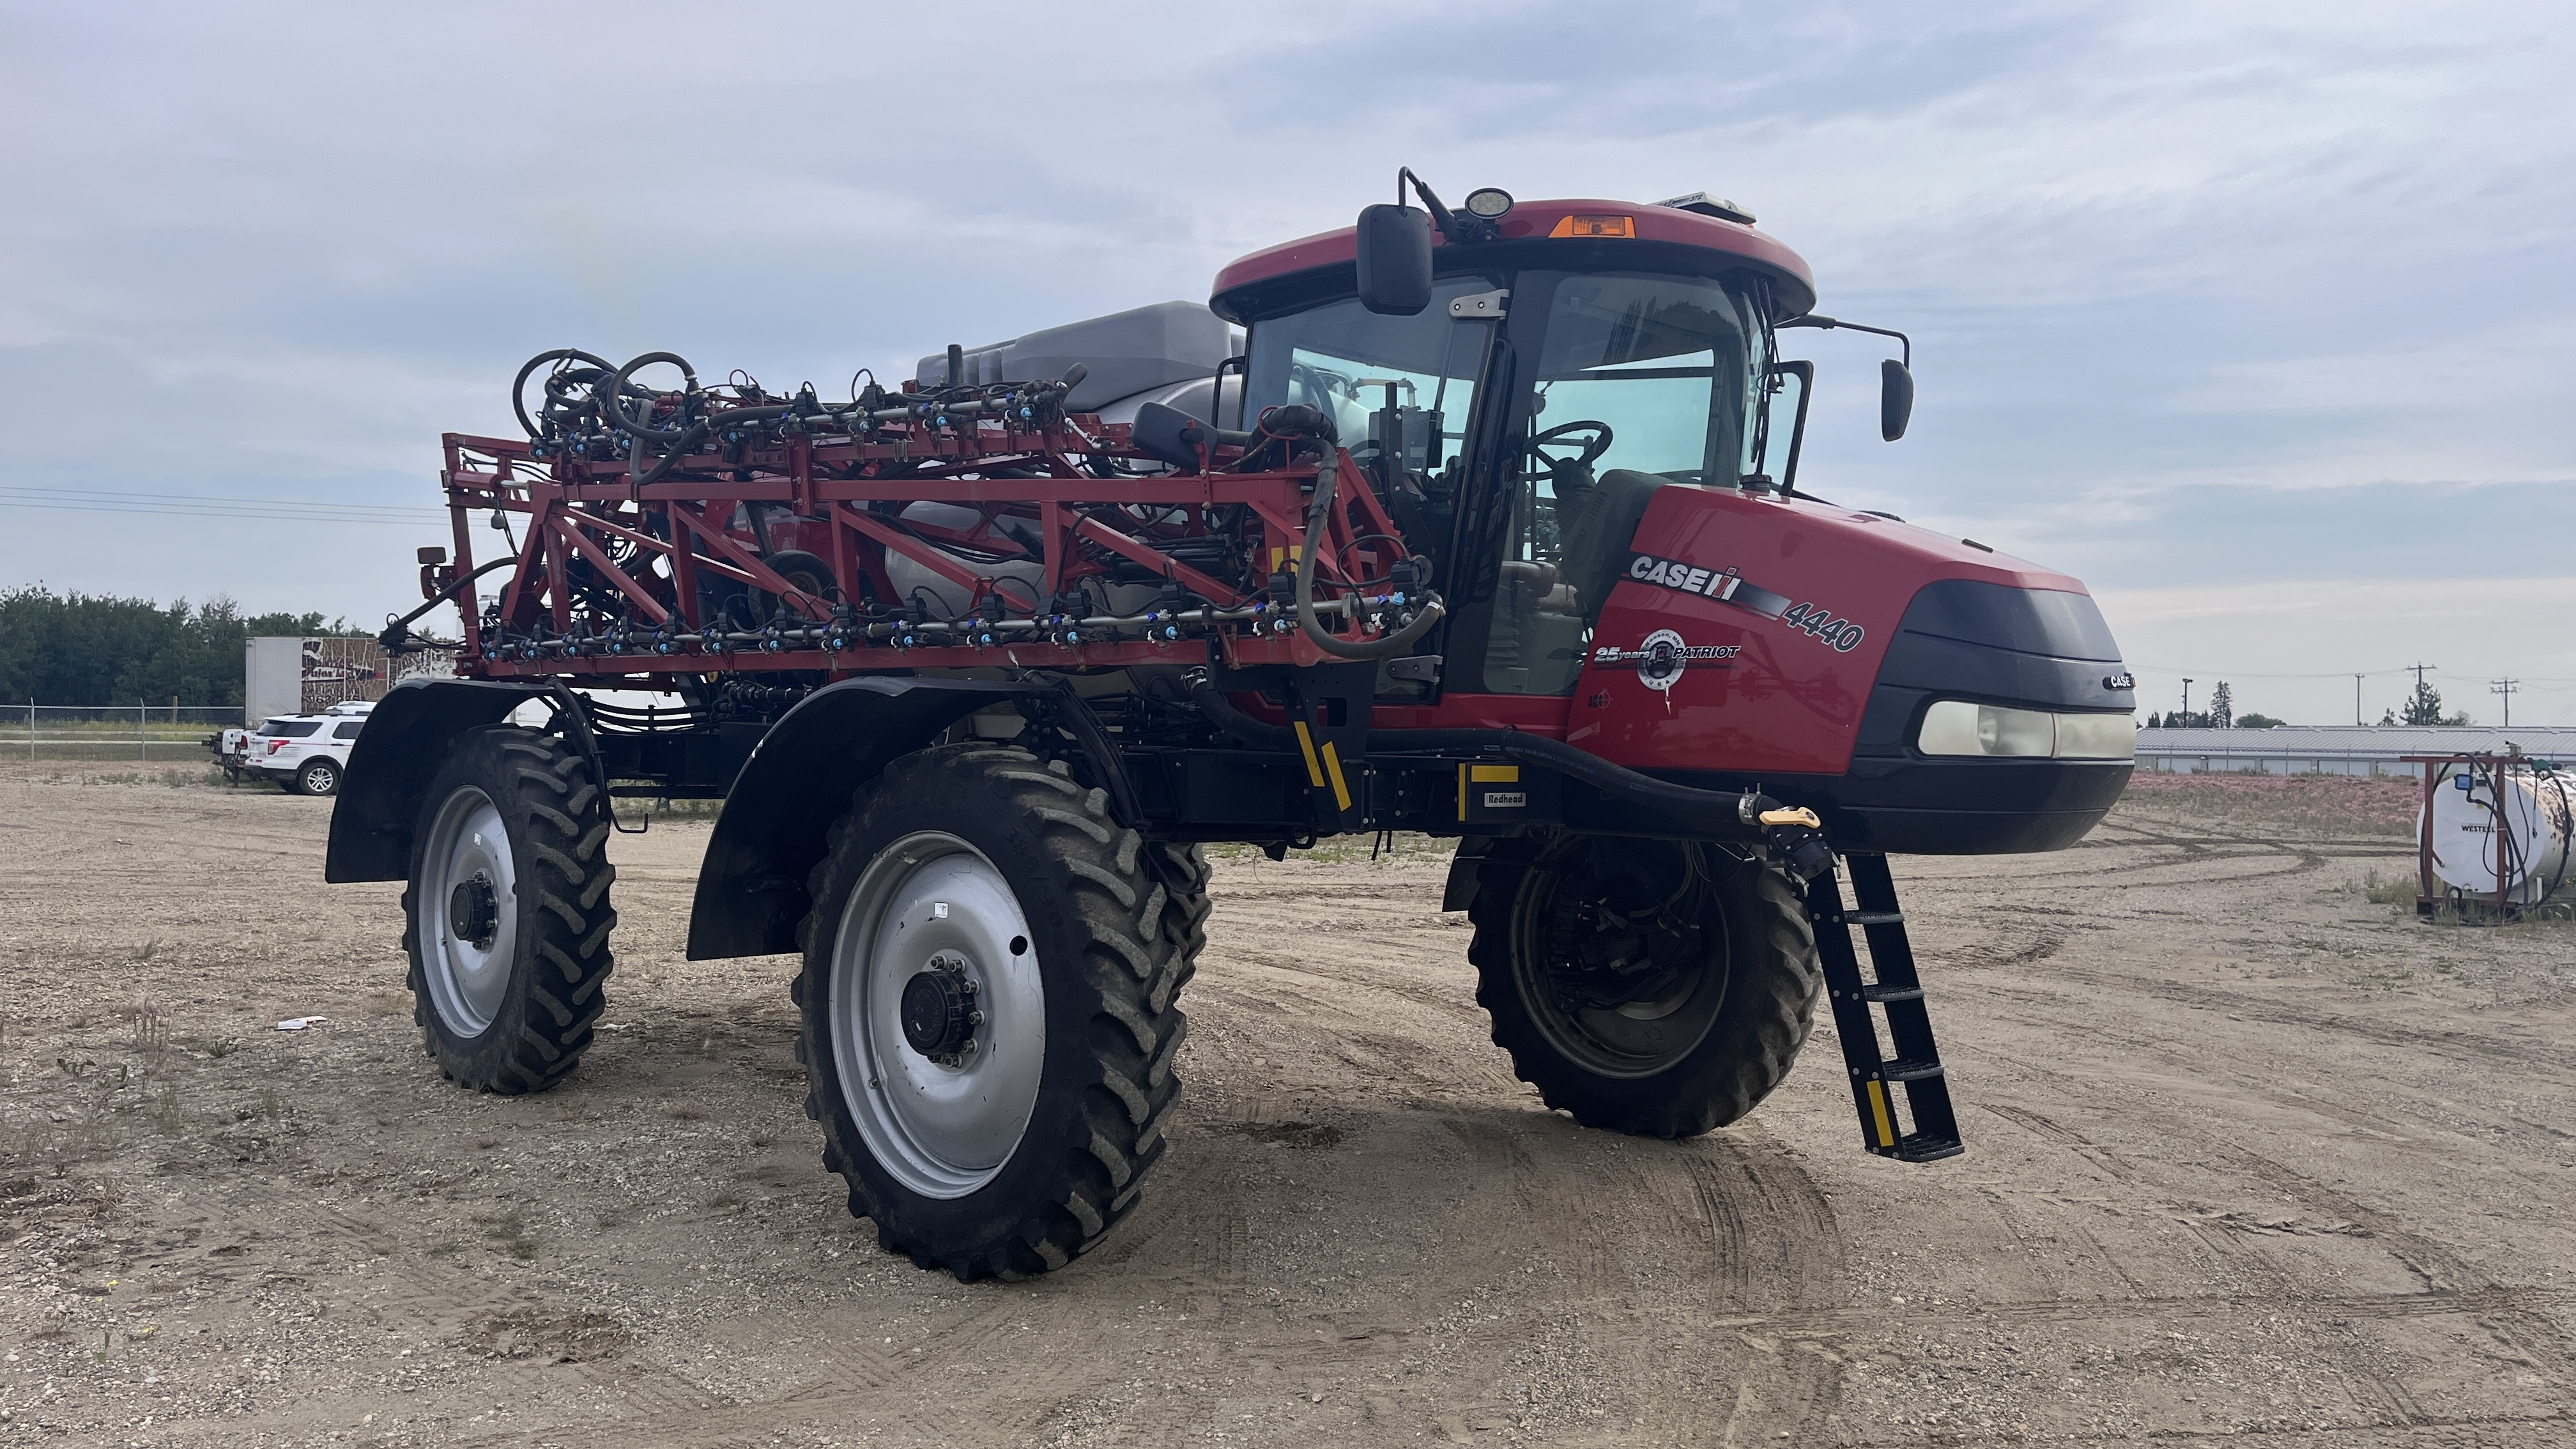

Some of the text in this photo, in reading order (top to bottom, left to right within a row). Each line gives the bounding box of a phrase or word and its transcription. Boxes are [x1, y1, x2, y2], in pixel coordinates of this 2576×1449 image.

[1630, 555, 1710, 593] CASE
[1782, 602, 1865, 653] 4440
[1672, 636, 1681, 646] MN
[1671, 645, 1742, 659] PATRIOT
[2110, 675, 2131, 687] CASE
[1489, 793, 1523, 804] Redhead
